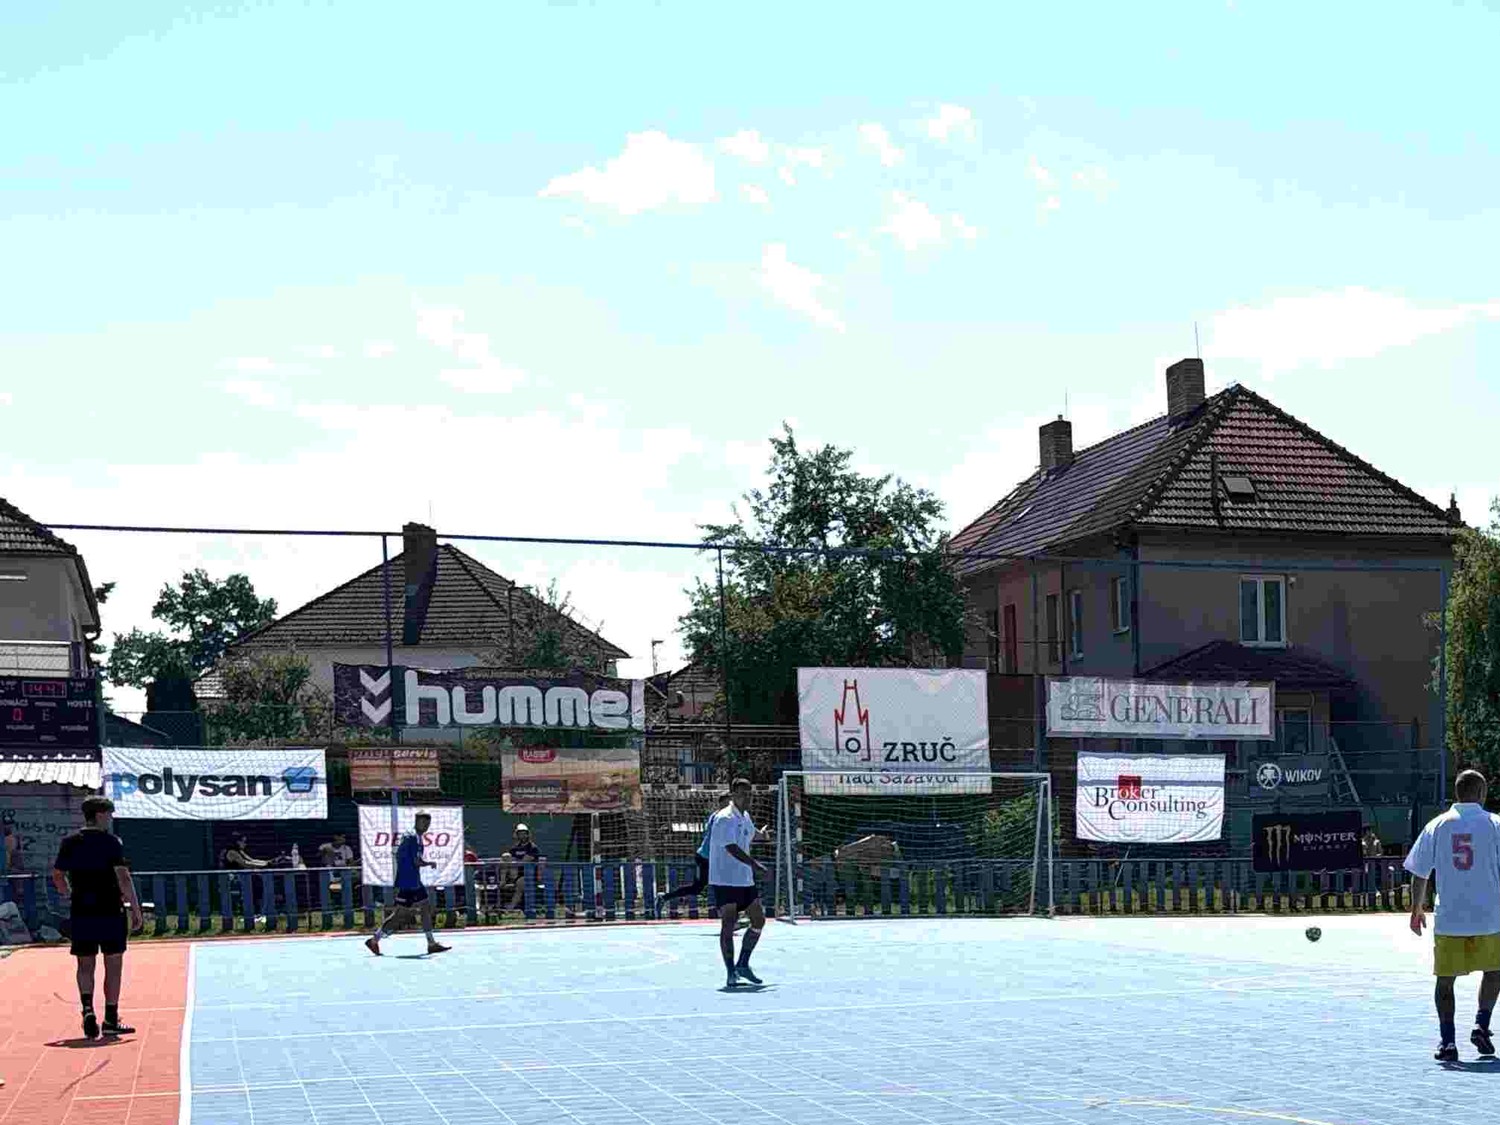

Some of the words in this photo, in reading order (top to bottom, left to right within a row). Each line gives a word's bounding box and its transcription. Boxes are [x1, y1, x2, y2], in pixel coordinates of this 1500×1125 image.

[404, 669, 645, 730] hummel
[1110, 694, 1262, 726] GENERALI
[882, 737, 957, 762] ZRUČ
[111, 767, 272, 802] polysan
[839, 767, 874, 784] nad
[1284, 768, 1322, 782] WIKOV
[1095, 783, 1160, 807] Broker
[1108, 795, 1207, 820] Consulting
[374, 832, 450, 847] DESO
[1294, 831, 1357, 843] MONSTER
[1451, 832, 1474, 870] 5
